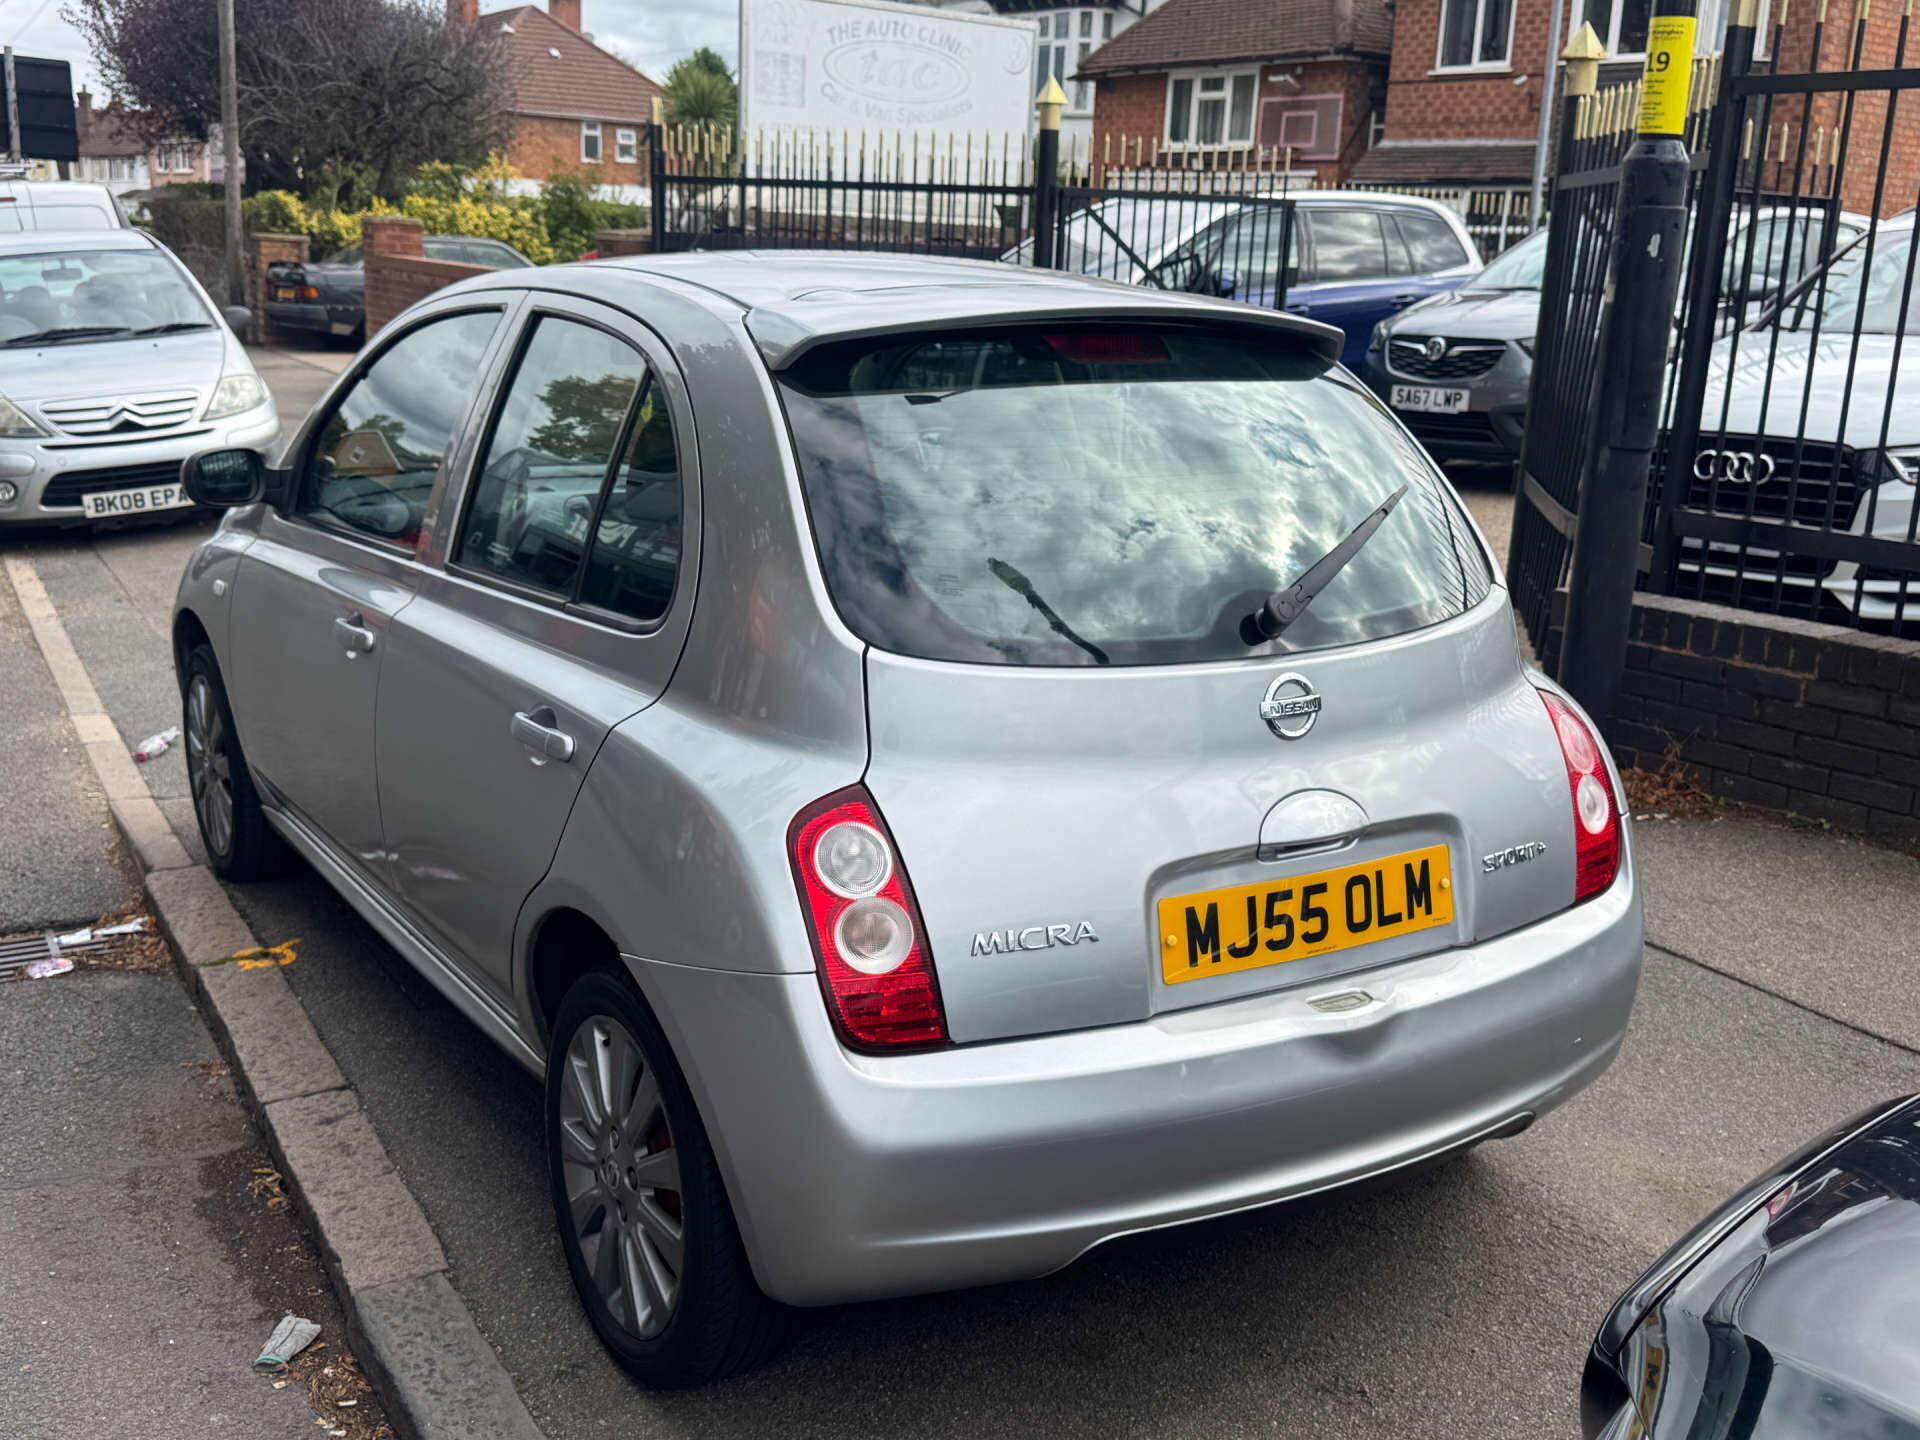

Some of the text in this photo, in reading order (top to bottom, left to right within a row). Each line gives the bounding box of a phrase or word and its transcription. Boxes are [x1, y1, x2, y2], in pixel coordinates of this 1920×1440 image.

[826, 21, 863, 46] THE
[866, 20, 914, 39] AUTO
[917, 26, 973, 60] CLINIC
[1646, 51, 1671, 73] 19
[865, 101, 893, 123] Van
[1396, 388, 1464, 409] SA67 LWP
[92, 492, 147, 514] BK08
[1269, 697, 1320, 717] NISSAN
[1185, 858, 1434, 968] MJ55 OLM
[970, 920, 1100, 957] MICRA
